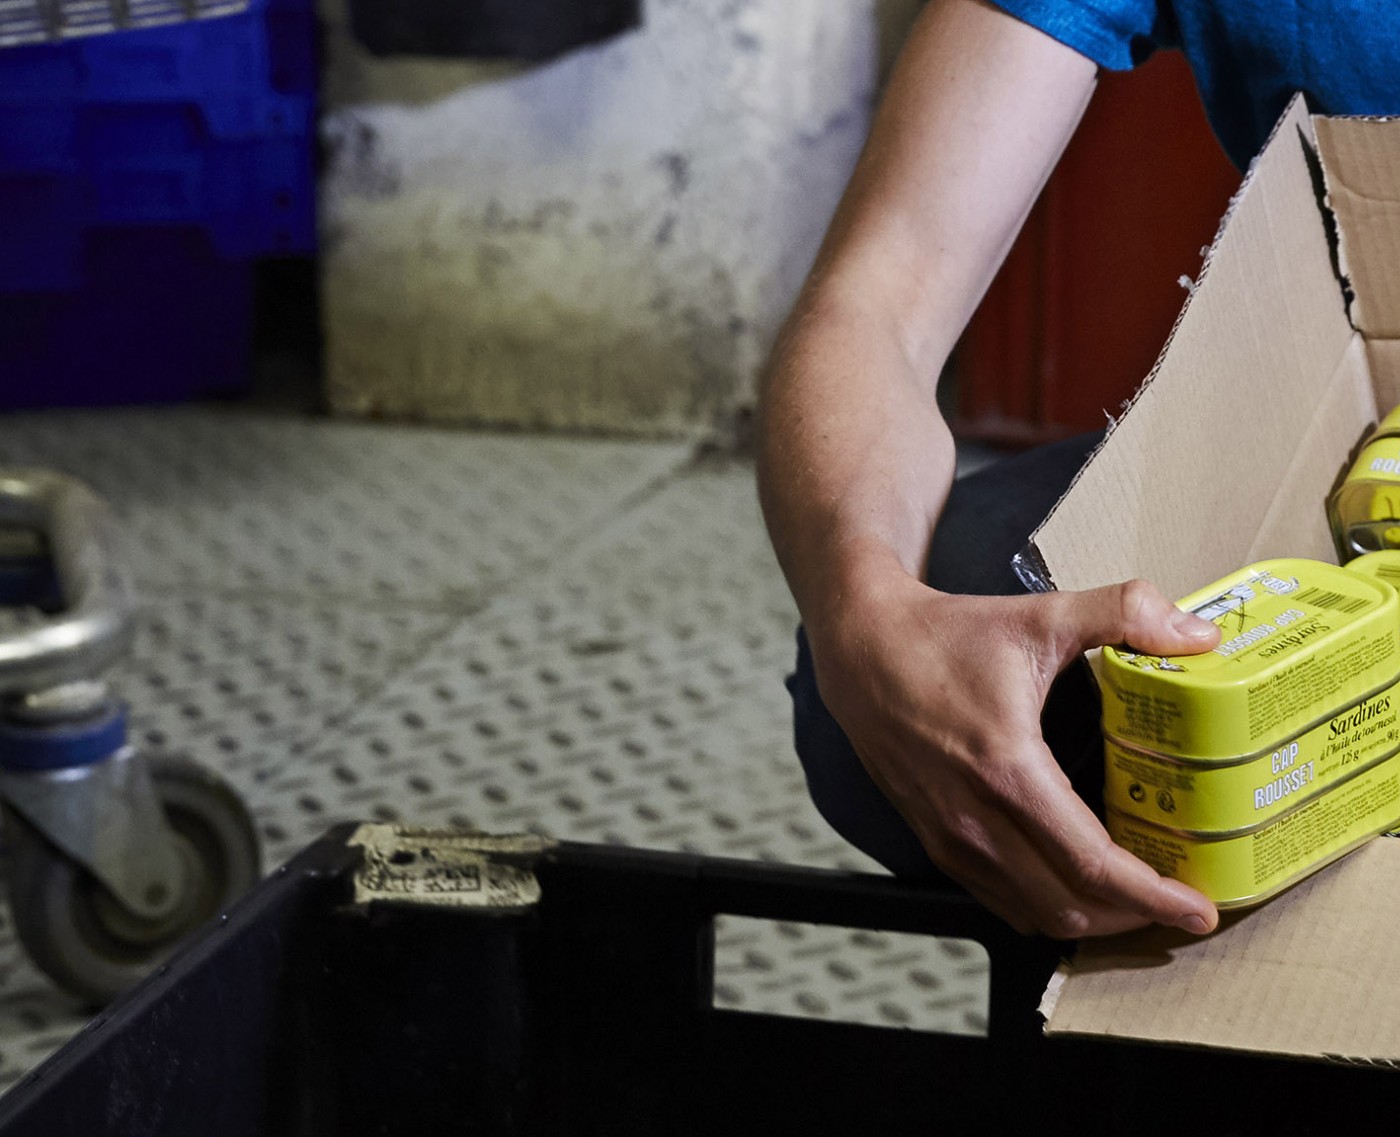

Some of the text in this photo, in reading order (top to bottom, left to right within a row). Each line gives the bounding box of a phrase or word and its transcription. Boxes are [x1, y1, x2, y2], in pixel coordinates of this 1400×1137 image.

[1213, 608, 1306, 657] CAP ROUSSET
[1257, 618, 1331, 660] Sardines
[1328, 695, 1391, 741] Sardines
[1271, 741, 1299, 775] CAP
[1254, 759, 1315, 810] ROUSSET
